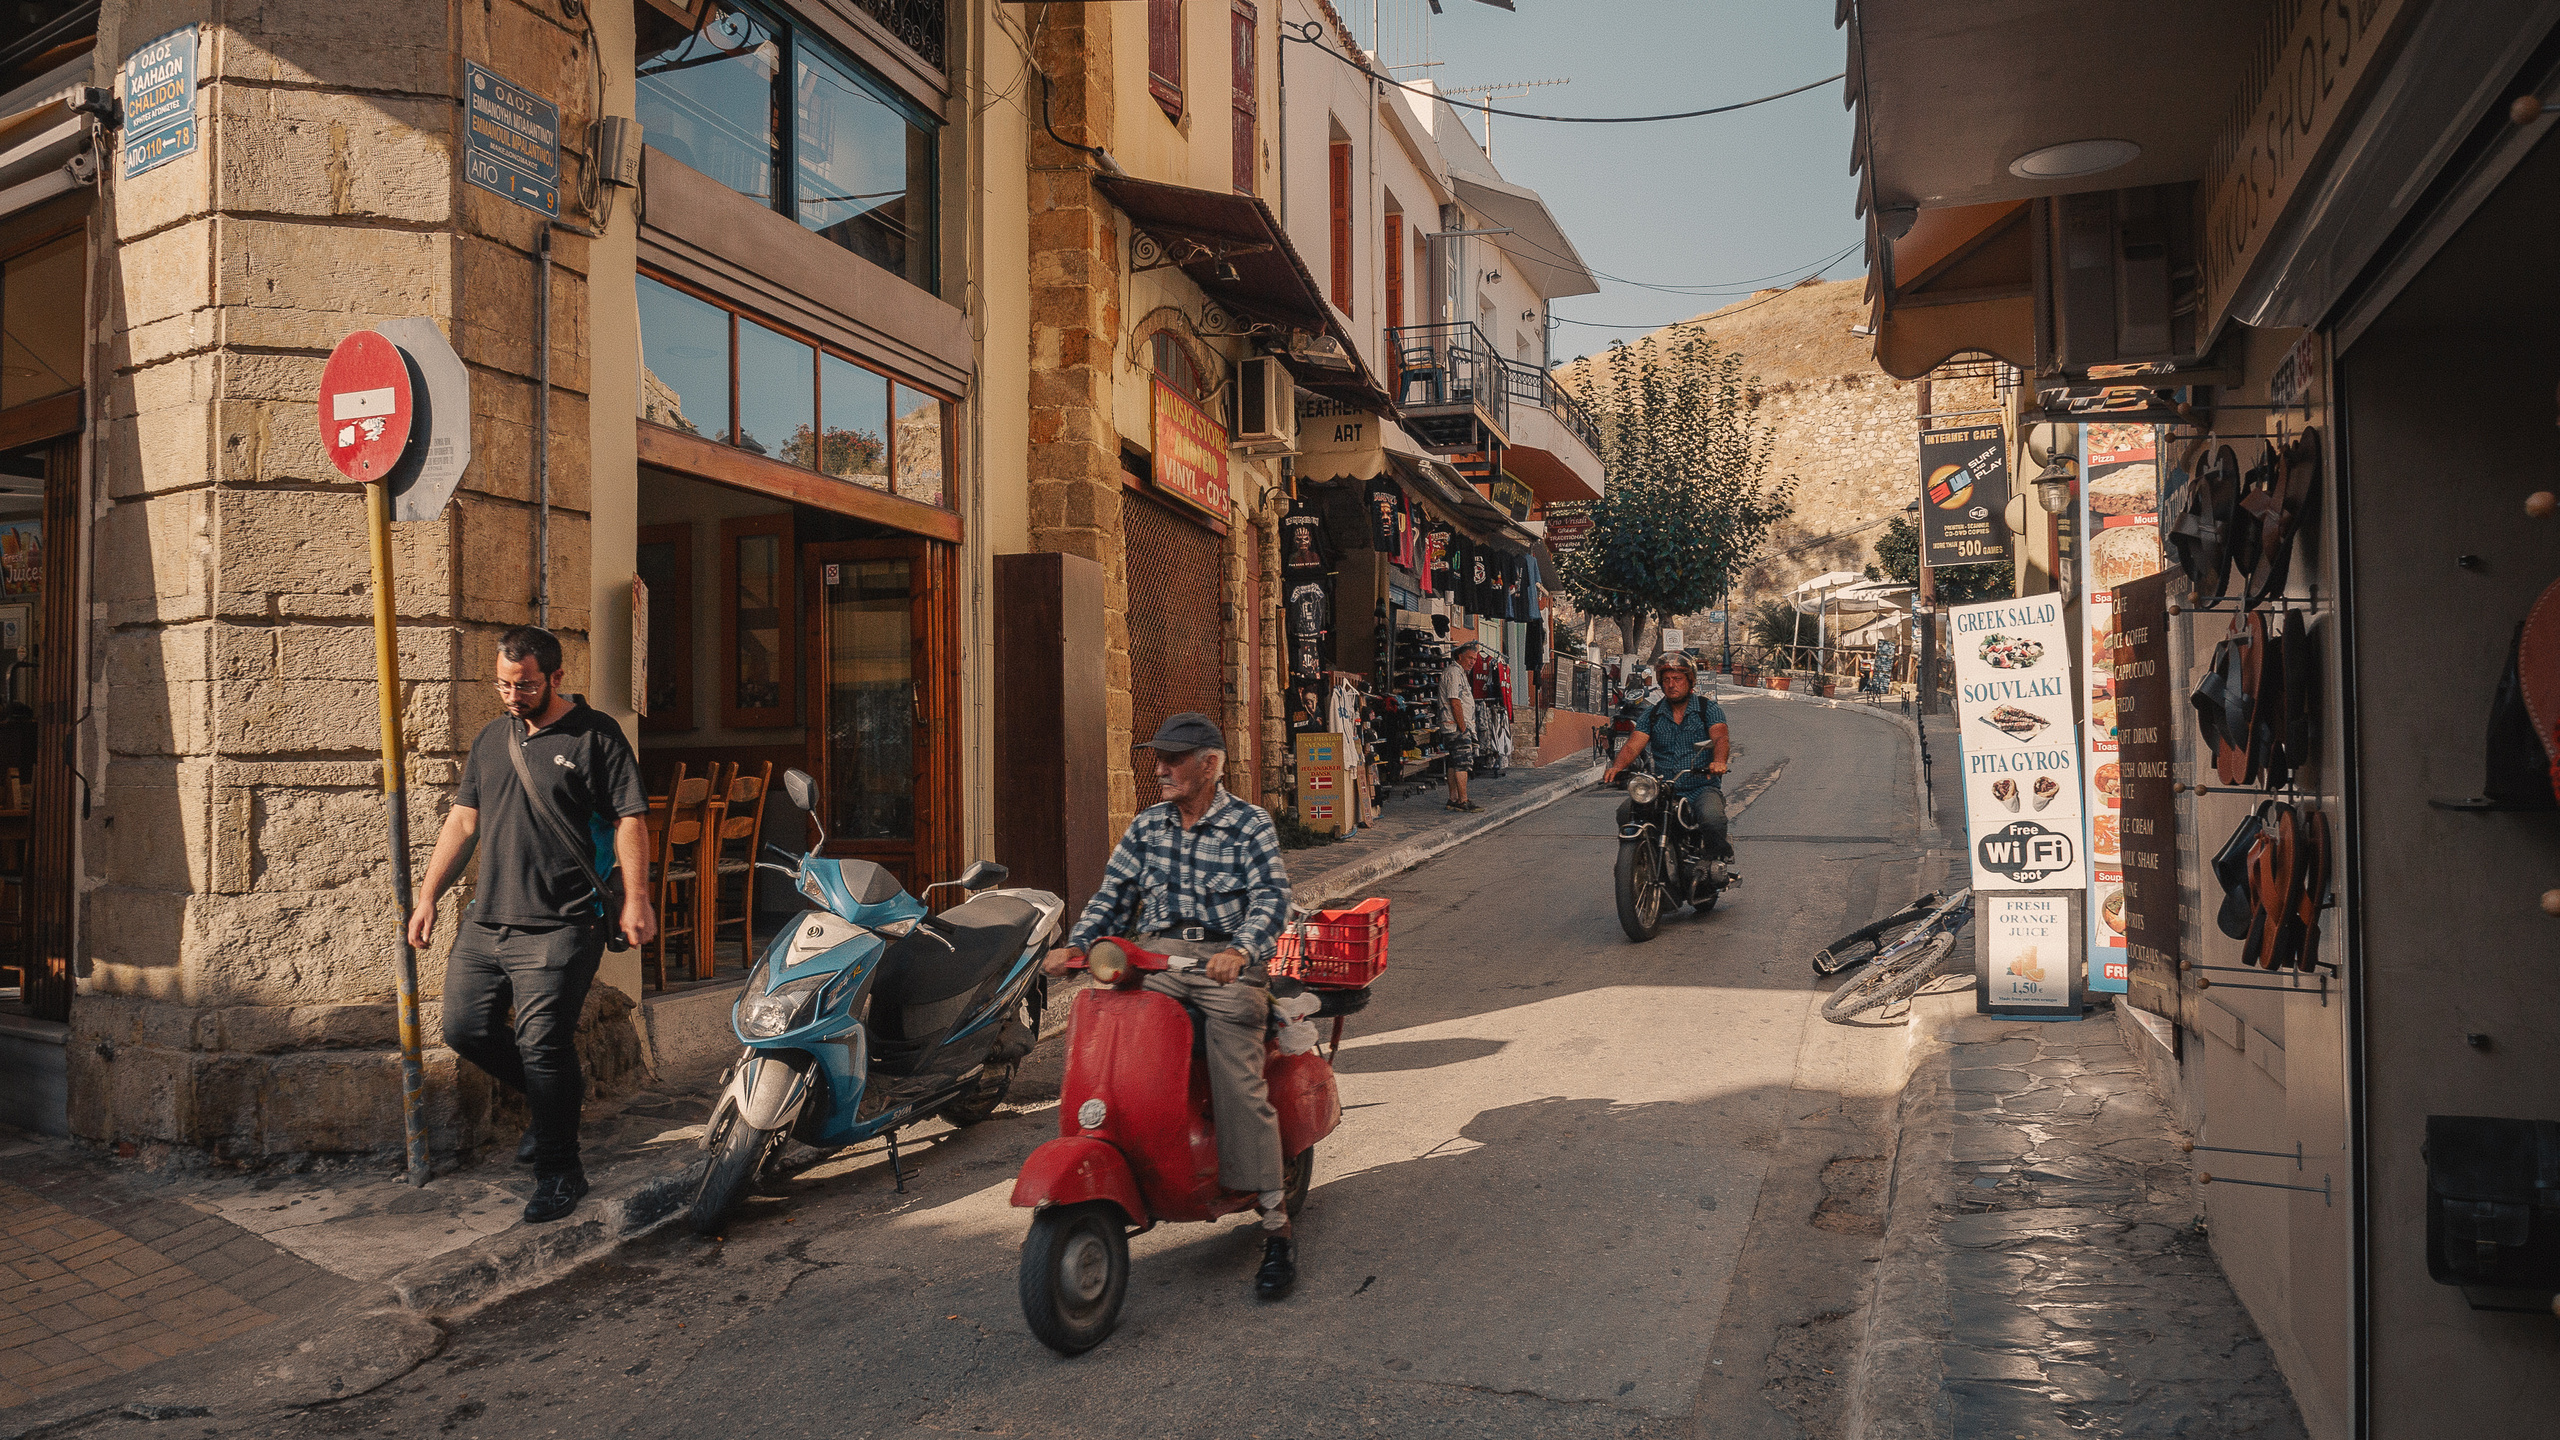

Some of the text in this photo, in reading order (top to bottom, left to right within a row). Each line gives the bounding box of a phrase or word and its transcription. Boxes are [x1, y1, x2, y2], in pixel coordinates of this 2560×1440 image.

[141, 43, 172, 70] ΟΔΟΣ
[131, 57, 183, 96] ΧΑΛΗΔΩΝ
[129, 78, 184, 118] CHALIDON
[495, 86, 534, 116] ΟΔΟΣ
[473, 93, 555, 147] ΕΜΜΑΝΟΥΗΛ ΜΠΑΛΑΝΤΙΝΟΥ
[127, 126, 190, 169] ΑΠΟ 110 78
[472, 114, 555, 168] EMMANOUIL MPALANTINOU
[2207, 0, 2351, 296] NIKOS SHOES
[471, 160, 554, 209] ΑΠΟ 1 9
[1160, 387, 1226, 455] MUSIC STORE
[1333, 423, 1363, 442] ART
[1924, 429, 1998, 445] INTERNET CAFE
[1968, 446, 1997, 469] SURF
[1973, 462, 1986, 473] AND
[2092, 454, 2115, 463] Pizza
[1975, 457, 2002, 480] PLAY
[1163, 454, 1197, 495] VINYL
[1206, 480, 1228, 512] CD'S
[1549, 534, 1586, 542] TRADITIONAL
[1958, 540, 1981, 557] 500
[1983, 546, 2003, 555] GAMES
[2095, 594, 2112, 603] Spa
[2112, 597, 2128, 615] CAFE
[1957, 603, 2055, 633] GREEK SALAD
[2113, 626, 2148, 650] ICE COFFEE
[2114, 660, 2155, 681] CAPPUCCINO
[1964, 676, 2062, 703] SOUVLAKI
[2116, 696, 2135, 713] FREDO
[2133, 727, 2158, 744] DRINKS
[1971, 750, 2070, 774] PITA GYROS
[2138, 761, 2167, 778] ORANGE
[2009, 825, 2039, 836] Free
[2132, 818, 2154, 836] CREAM
[2138, 852, 2159, 870] SHAKE
[2012, 870, 2042, 882] spot
[2007, 901, 2050, 911] FRESH
[2000, 914, 2058, 924] ORANGE
[2009, 927, 2049, 937] JUICE
[2127, 945, 2159, 966] COCKTAILS
